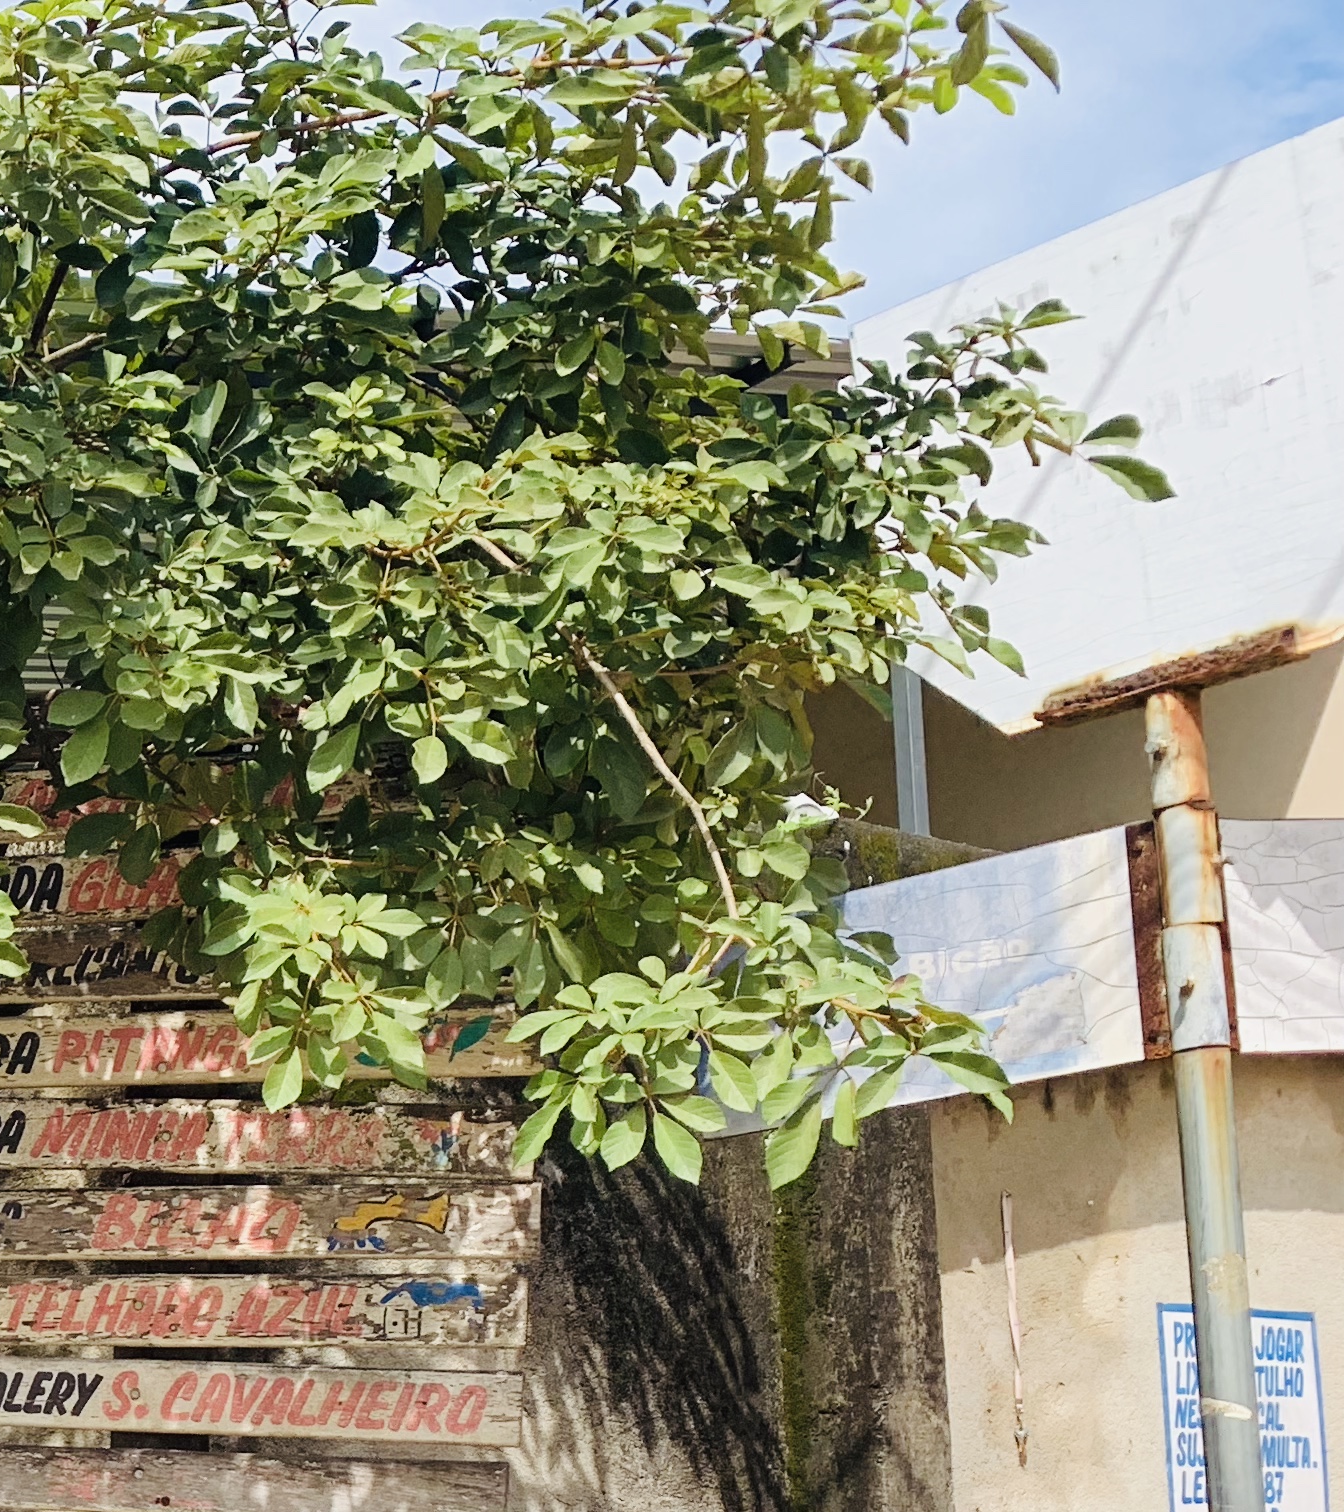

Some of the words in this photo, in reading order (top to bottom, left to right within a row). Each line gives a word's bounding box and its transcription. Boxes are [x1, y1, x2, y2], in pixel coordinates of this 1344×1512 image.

[52, 1025, 248, 1074] PITANG
[30, 1107, 207, 1160] MINHA
[6, 1281, 223, 1337] TELHADO
[227, 1284, 364, 1338] AZUL
[1255, 1326, 1305, 1364] JOGAR
[160, 1371, 489, 1435] CAVALHEIRO
[1255, 1366, 1305, 1398] TULHO
